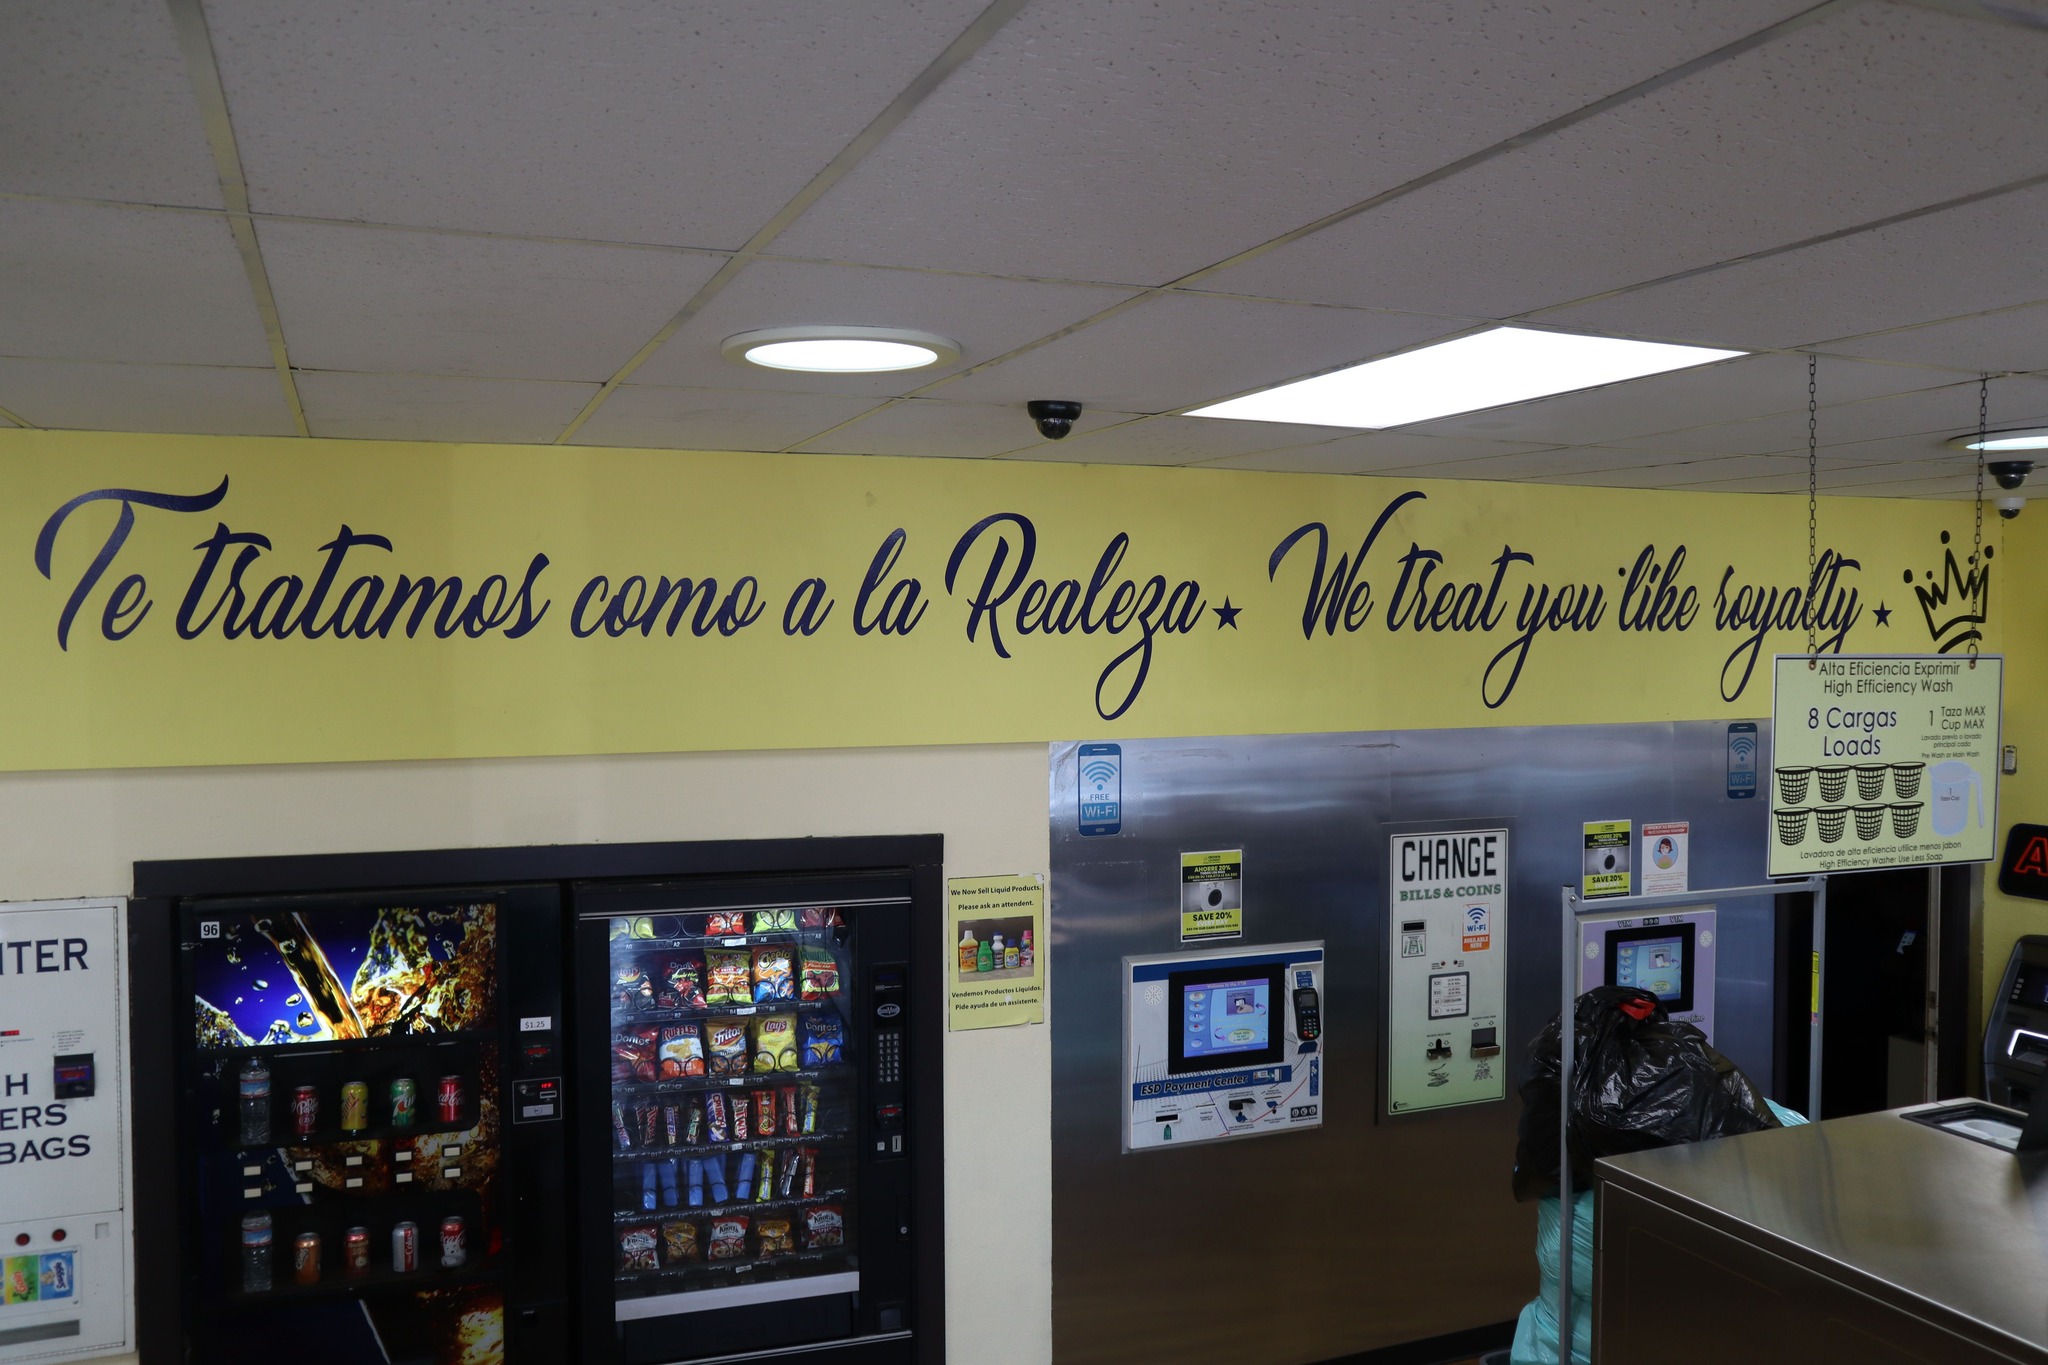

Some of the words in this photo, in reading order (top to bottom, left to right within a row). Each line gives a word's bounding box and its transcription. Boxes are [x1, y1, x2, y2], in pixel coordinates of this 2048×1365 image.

[34, 474, 229, 652] Te
[175, 522, 551, 640] tratamos
[570, 575, 766, 638] como
[782, 577, 834, 636] a
[852, 527, 929, 636] la
[945, 512, 1206, 720] Realeza
[1268, 490, 1427, 640] We
[1386, 541, 1535, 633] treat
[1482, 583, 1607, 709] you
[1617, 544, 1700, 632] like
[1713, 548, 1863, 703] royalty
[1818, 661, 1846, 677] Alta
[1849, 661, 1910, 676] Eficiencia
[1914, 660, 1961, 679] Exprimir
[1824, 679, 1853, 697] High
[1857, 678, 1918, 696] Efficiency
[1921, 677, 1954, 693] Wash
[1929, 710, 1934, 726] 1
[1941, 706, 1963, 717] Taza
[1964, 705, 1986, 717] MAX
[1808, 707, 1819, 730] 8
[1826, 706, 1897, 733] Cargas
[1941, 719, 1961, 732] Cup
[1963, 718, 1985, 730] MAX
[1823, 734, 1881, 757] Loads
[1933, 741, 1956, 749] principal
[1090, 793, 1110, 801] FREE
[1084, 805, 1117, 818] Wi-Fi
[1800, 849, 1835, 859] Lavadora
[1836, 848, 1846, 856] de
[1847, 847, 1862, 856] alta
[1863, 844, 1897, 855] eficiencia
[1897, 843, 1918, 853] utilice
[1919, 842, 1942, 851] menos
[1942, 840, 1962, 851] jabon
[1402, 836, 1497, 882] CHANGE
[1819, 859, 1836, 870] High
[1837, 857, 1871, 868] Efficiency
[1898, 854, 1910, 863] Use
[1911, 853, 1926, 862] Less
[1926, 852, 1943, 863] Soap
[1592, 876, 1609, 884] SAVE
[1610, 874, 1623, 882] 20%
[978, 887, 990, 895] Sell
[990, 886, 1011, 895] Liquid
[1011, 884, 1042, 892] Products.
[1400, 888, 1441, 901] BILLS
[1443, 888, 1453, 898] &
[1456, 883, 1502, 897] COINS
[1001, 900, 1034, 908] attendent.
[1193, 912, 1214, 922] SAVE
[1215, 911, 1232, 920] 20%
[1669, 914, 1684, 923] VTM
[203, 923, 219, 938] 96
[0, 937, 89, 975] TER
[951, 990, 983, 998] Vendemos
[984, 987, 1014, 996] Productos
[970, 1002, 989, 1010] ayuda
[1007, 998, 1039, 1006] assistente.
[524, 1020, 545, 1029] $1.25
[765, 1019, 788, 1033] Lay's
[805, 1021, 838, 1032] Doritos
[615, 1033, 651, 1046] Doritos
[661, 1024, 698, 1041] RUFFLES
[714, 1027, 742, 1046] Fritos
[1140, 1083, 1161, 1096] ESD
[1165, 1078, 1212, 1095] Payment
[711, 1093, 727, 1128] CRUNCH
[735, 1106, 747, 1140] TWIX
